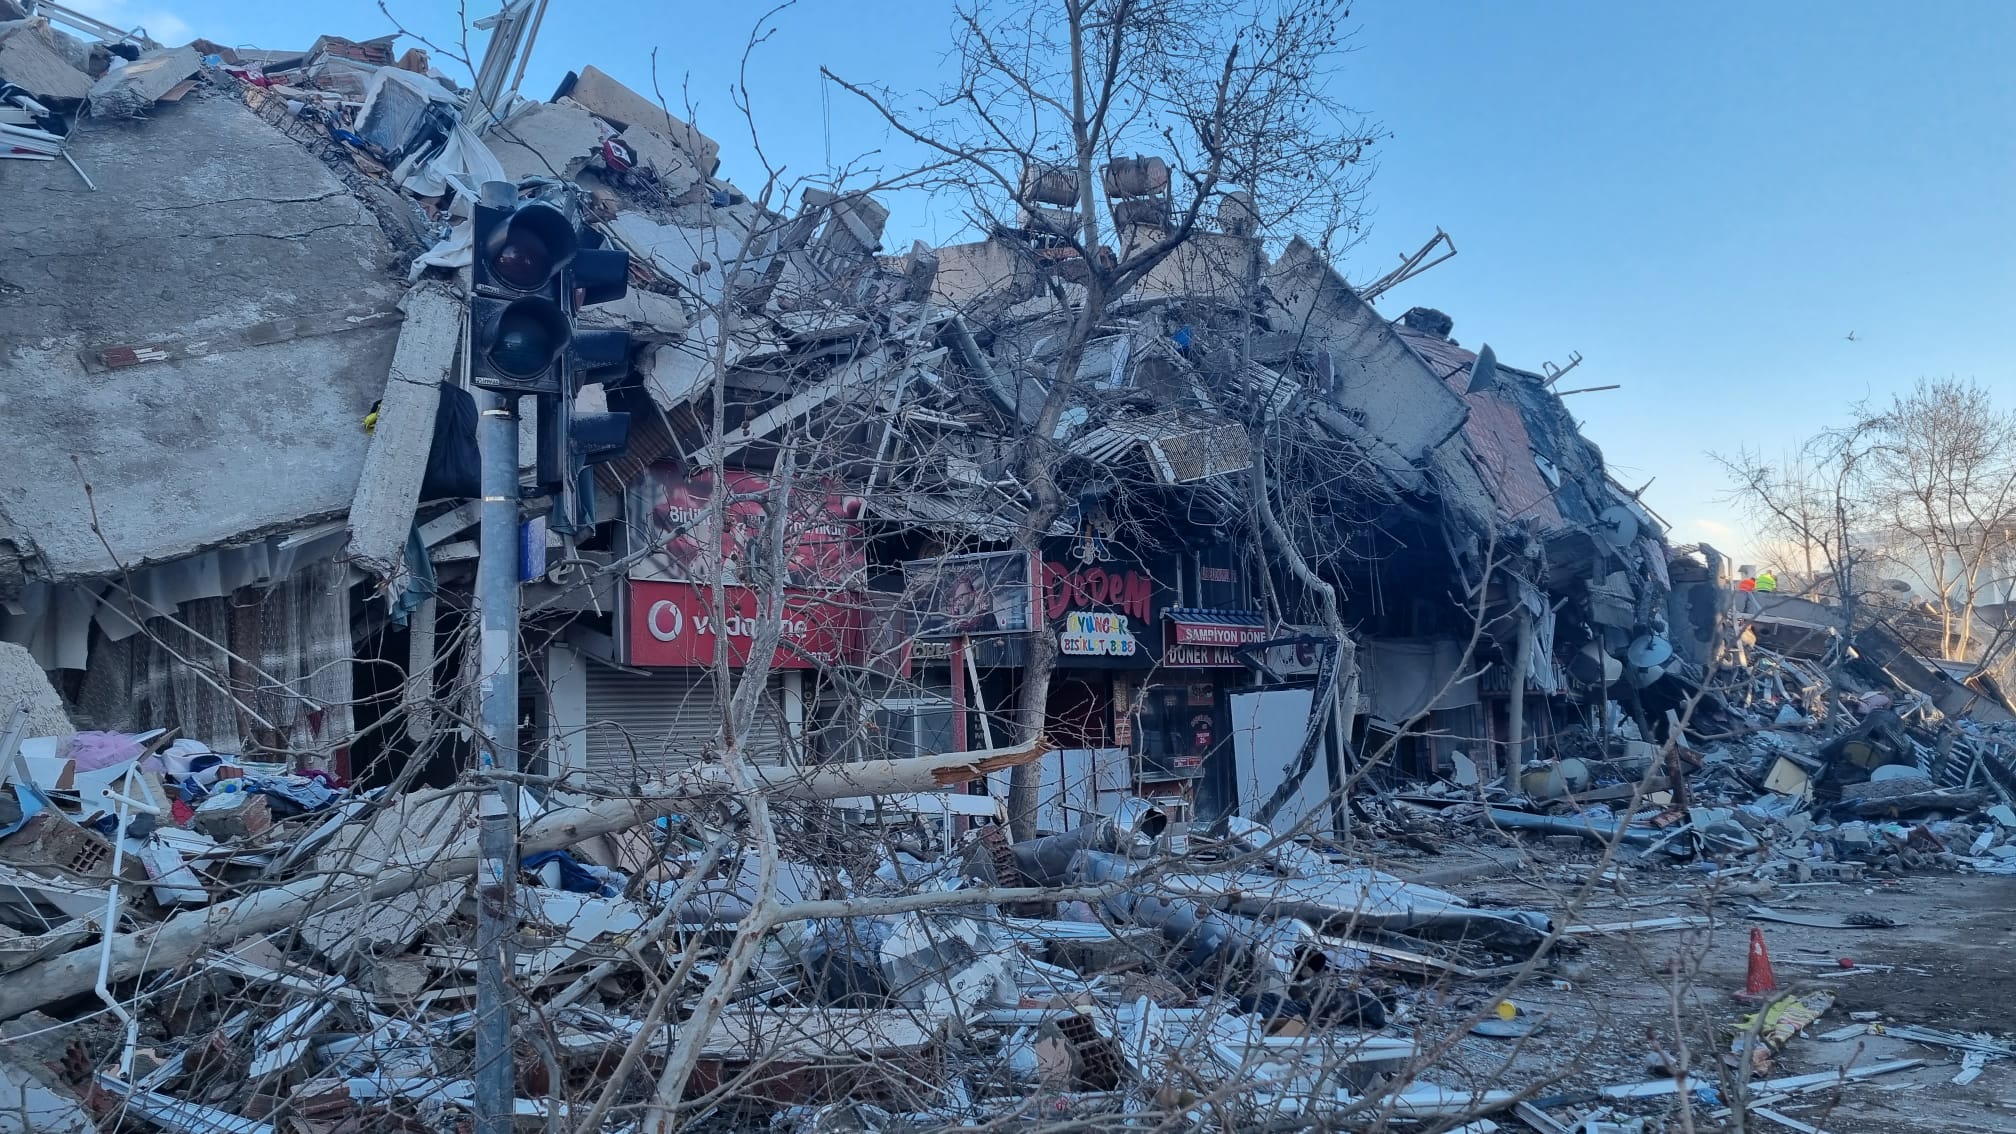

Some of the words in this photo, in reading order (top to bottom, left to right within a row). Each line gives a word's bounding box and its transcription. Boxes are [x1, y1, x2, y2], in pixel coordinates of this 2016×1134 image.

[691, 614, 808, 638] vdane
[1240, 629, 1271, 643] DÖNE
[1110, 638, 1134, 653] BEBE
[1214, 646, 1265, 664] KAVA
